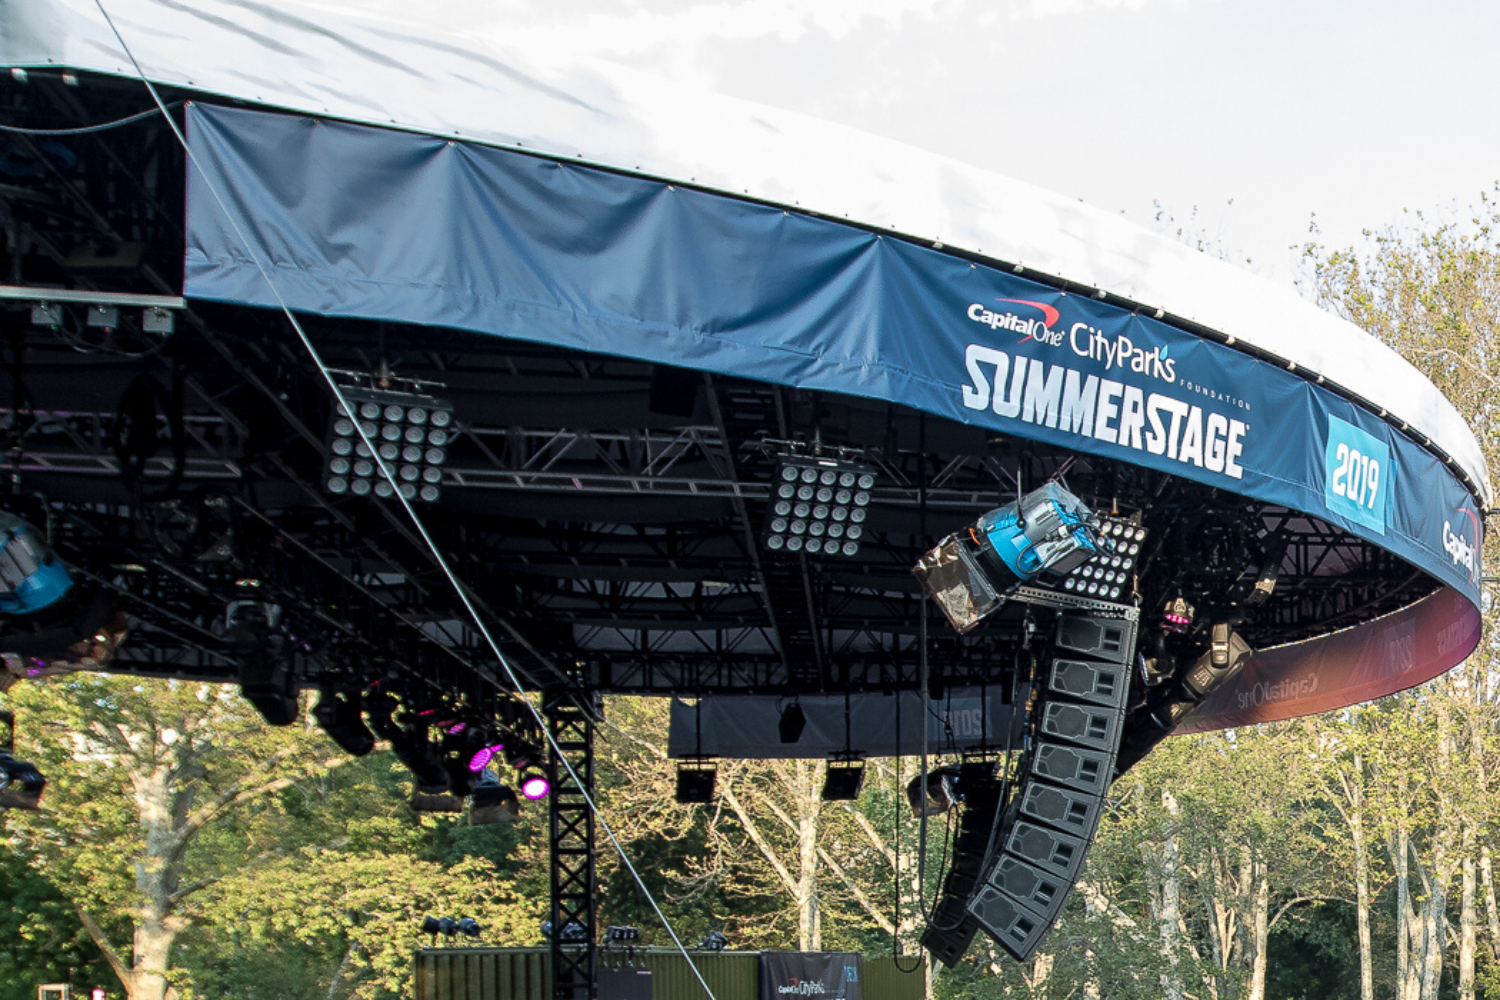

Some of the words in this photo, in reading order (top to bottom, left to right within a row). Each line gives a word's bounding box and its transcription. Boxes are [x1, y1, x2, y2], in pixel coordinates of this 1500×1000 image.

[1070, 322, 1176, 383] CityParks
[961, 343, 1246, 480] SUMMERSTAGE
[1180, 379, 1251, 410] FOUNDATION
[1332, 443, 1380, 509] 2019
